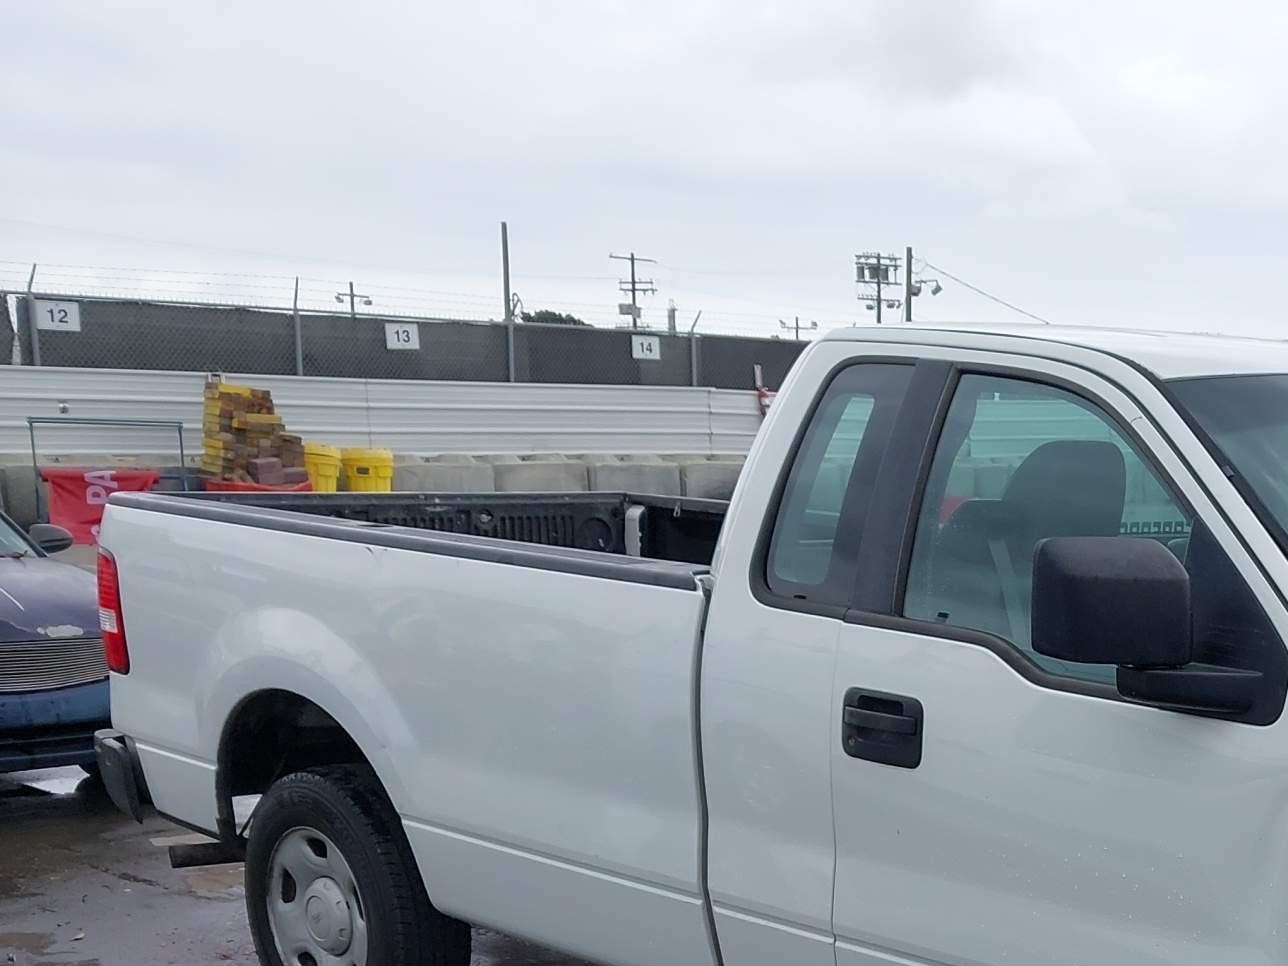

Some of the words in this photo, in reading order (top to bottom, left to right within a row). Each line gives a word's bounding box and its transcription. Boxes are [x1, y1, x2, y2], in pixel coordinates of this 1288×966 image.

[47, 308, 69, 324] 12
[394, 329, 411, 343] 13
[639, 341, 653, 353] 14
